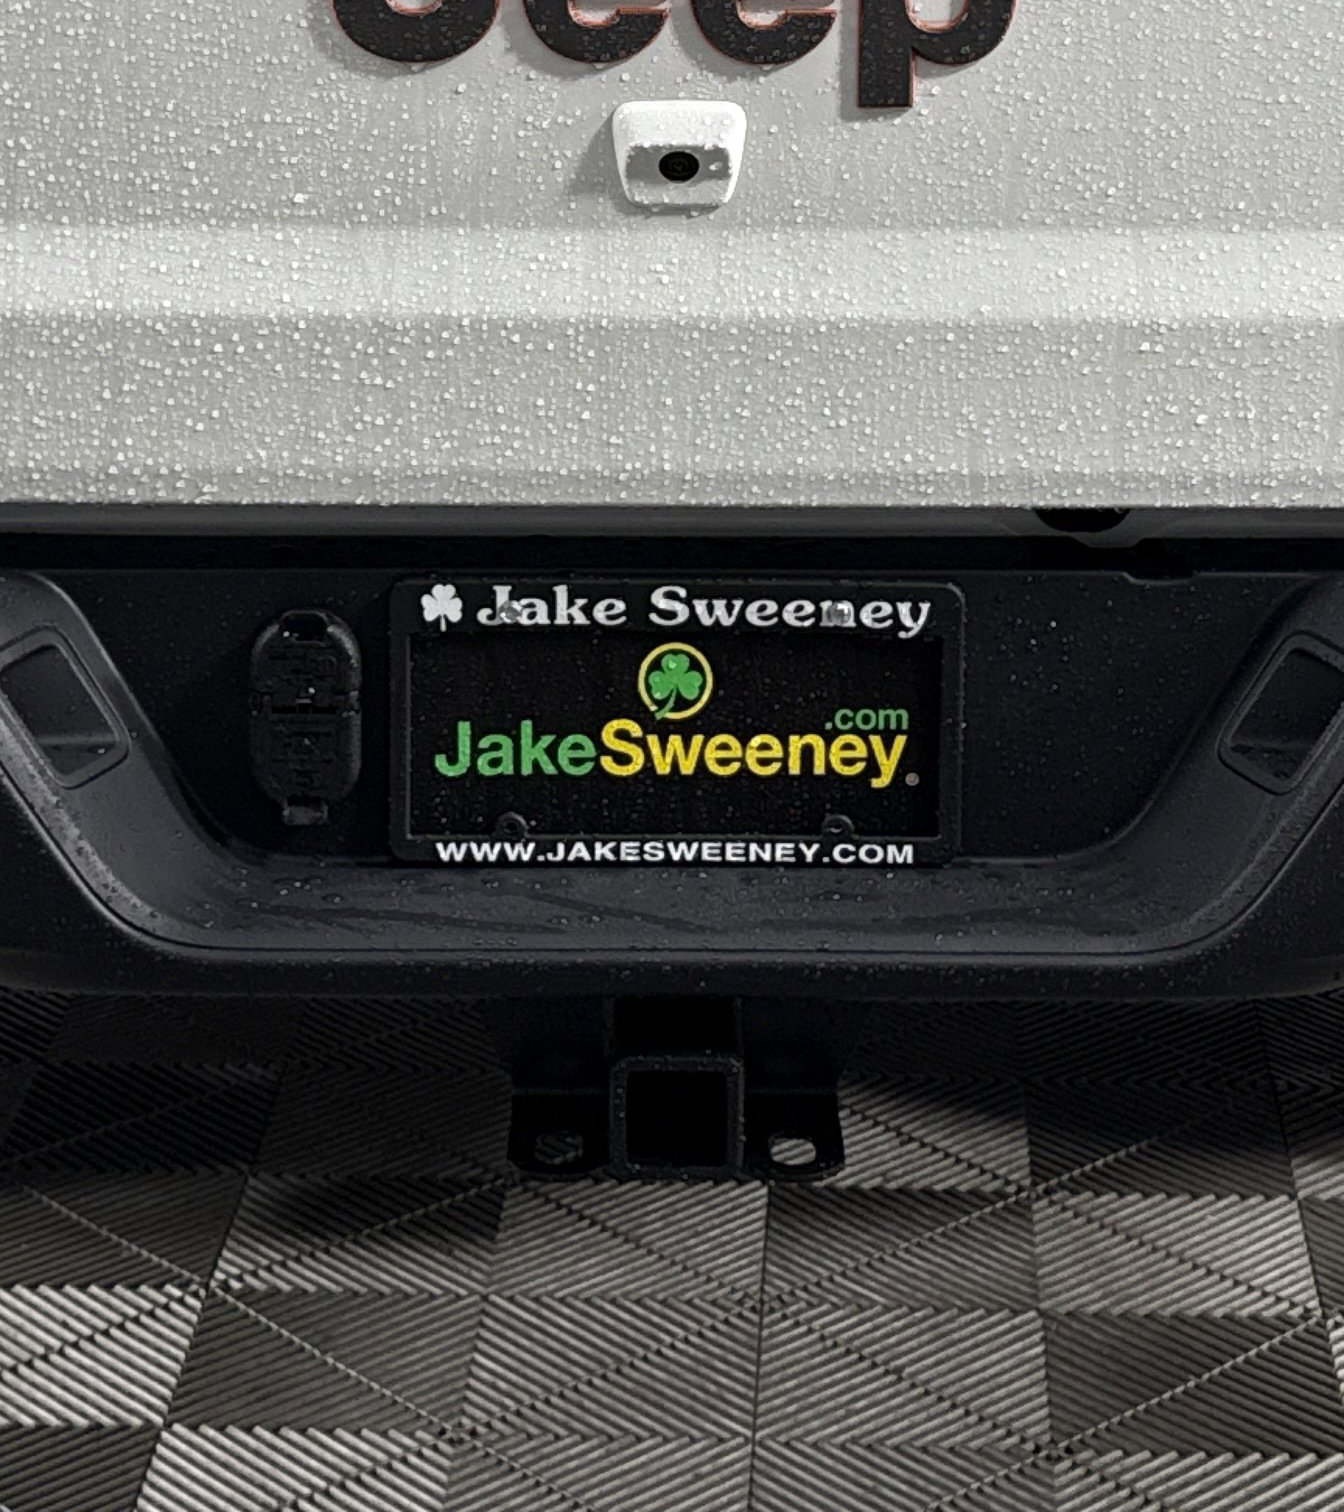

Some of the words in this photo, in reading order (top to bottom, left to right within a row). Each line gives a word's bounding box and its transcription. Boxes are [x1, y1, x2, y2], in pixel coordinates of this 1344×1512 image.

[476, 584, 627, 628] Jake
[648, 584, 931, 639] Sweeney
[824, 707, 910, 731] .com
[436, 840, 915, 865] WWW.JAKESWEENEY.COM
